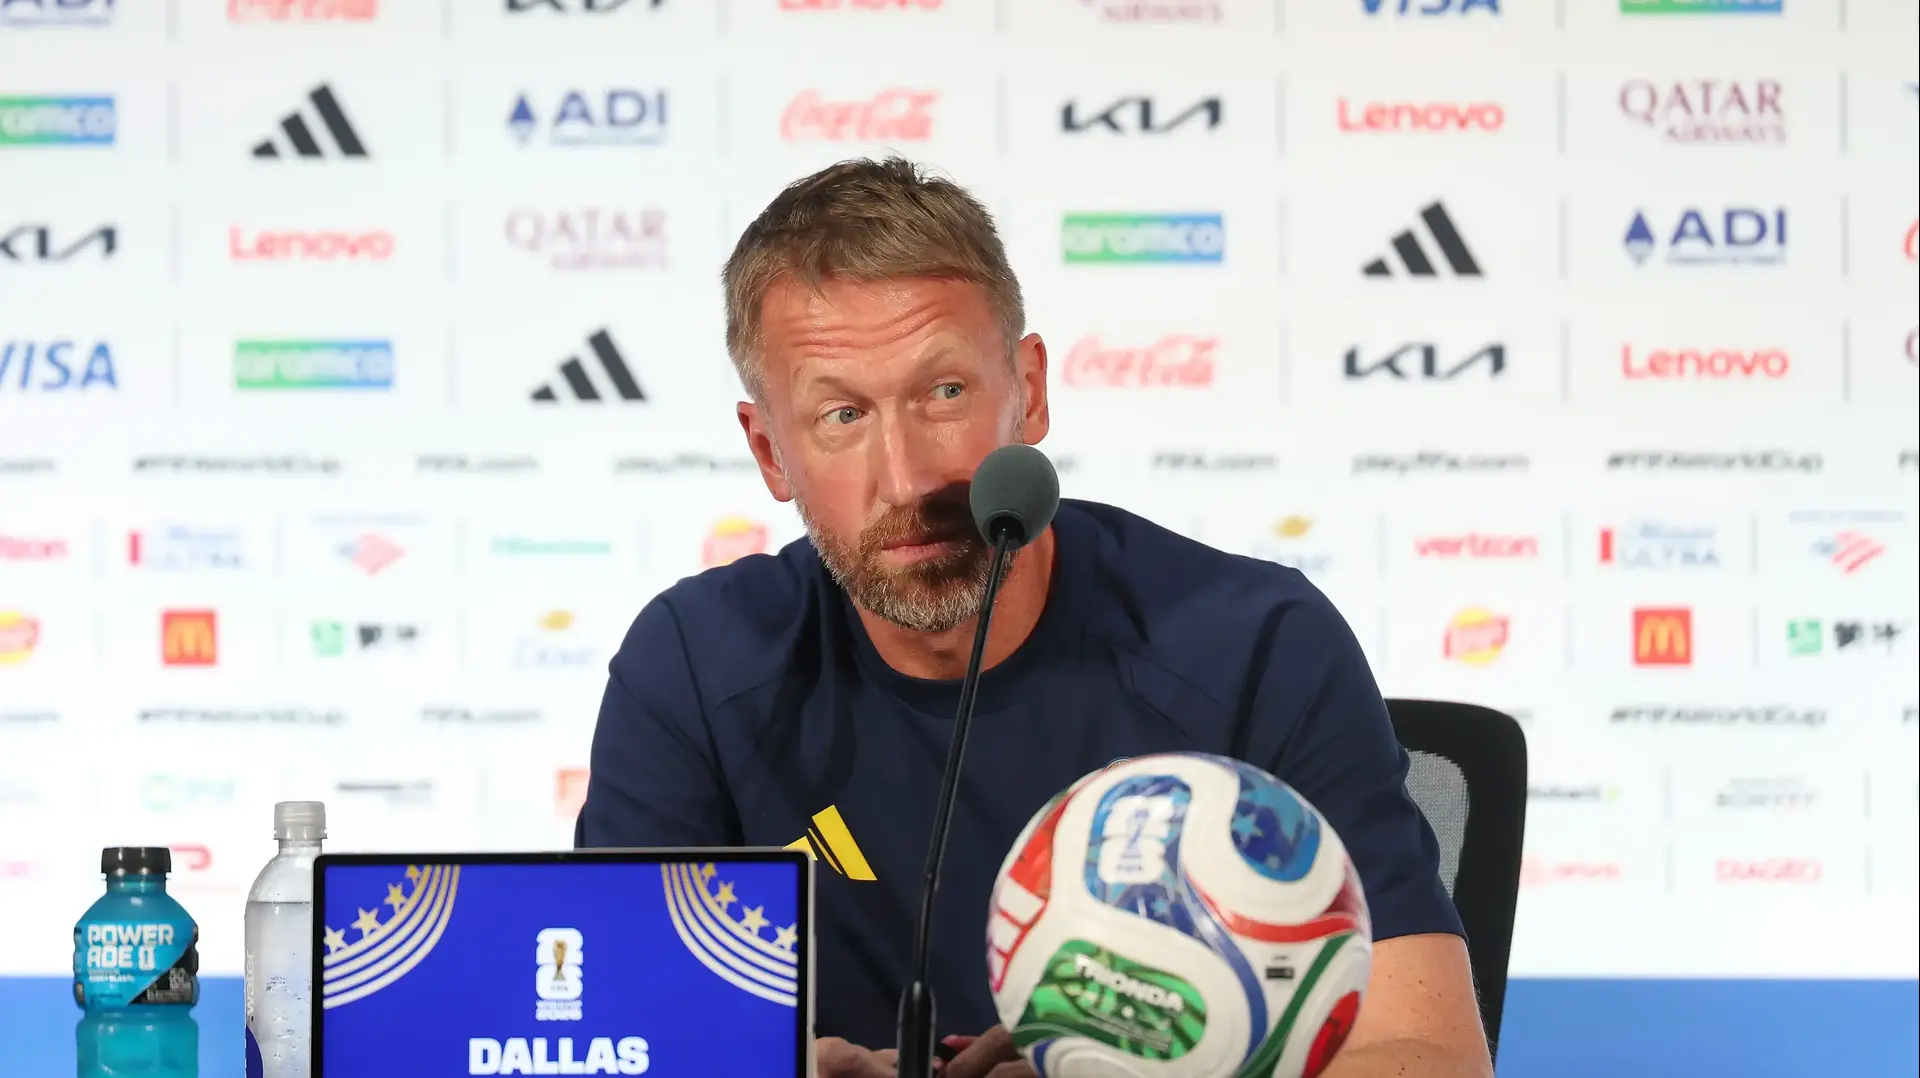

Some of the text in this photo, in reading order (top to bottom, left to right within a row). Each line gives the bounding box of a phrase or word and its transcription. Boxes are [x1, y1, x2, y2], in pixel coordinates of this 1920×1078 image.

[553, 90, 668, 128] ADI
[1061, 97, 1222, 133] KIA
[1338, 99, 1504, 133] Lenovo
[1619, 79, 1783, 126] QATAR
[230, 228, 394, 261] Lenovo
[505, 209, 667, 251] QATAR
[1063, 222, 1223, 254] aramco
[1671, 208, 1787, 247] ADI
[1343, 343, 1505, 379] KIA
[1622, 345, 1790, 379] Lenovo
[87, 923, 175, 945] POWER
[86, 944, 134, 969] ADE
[246, 949, 255, 1016] water
[468, 1036, 650, 1076] DALLAS
